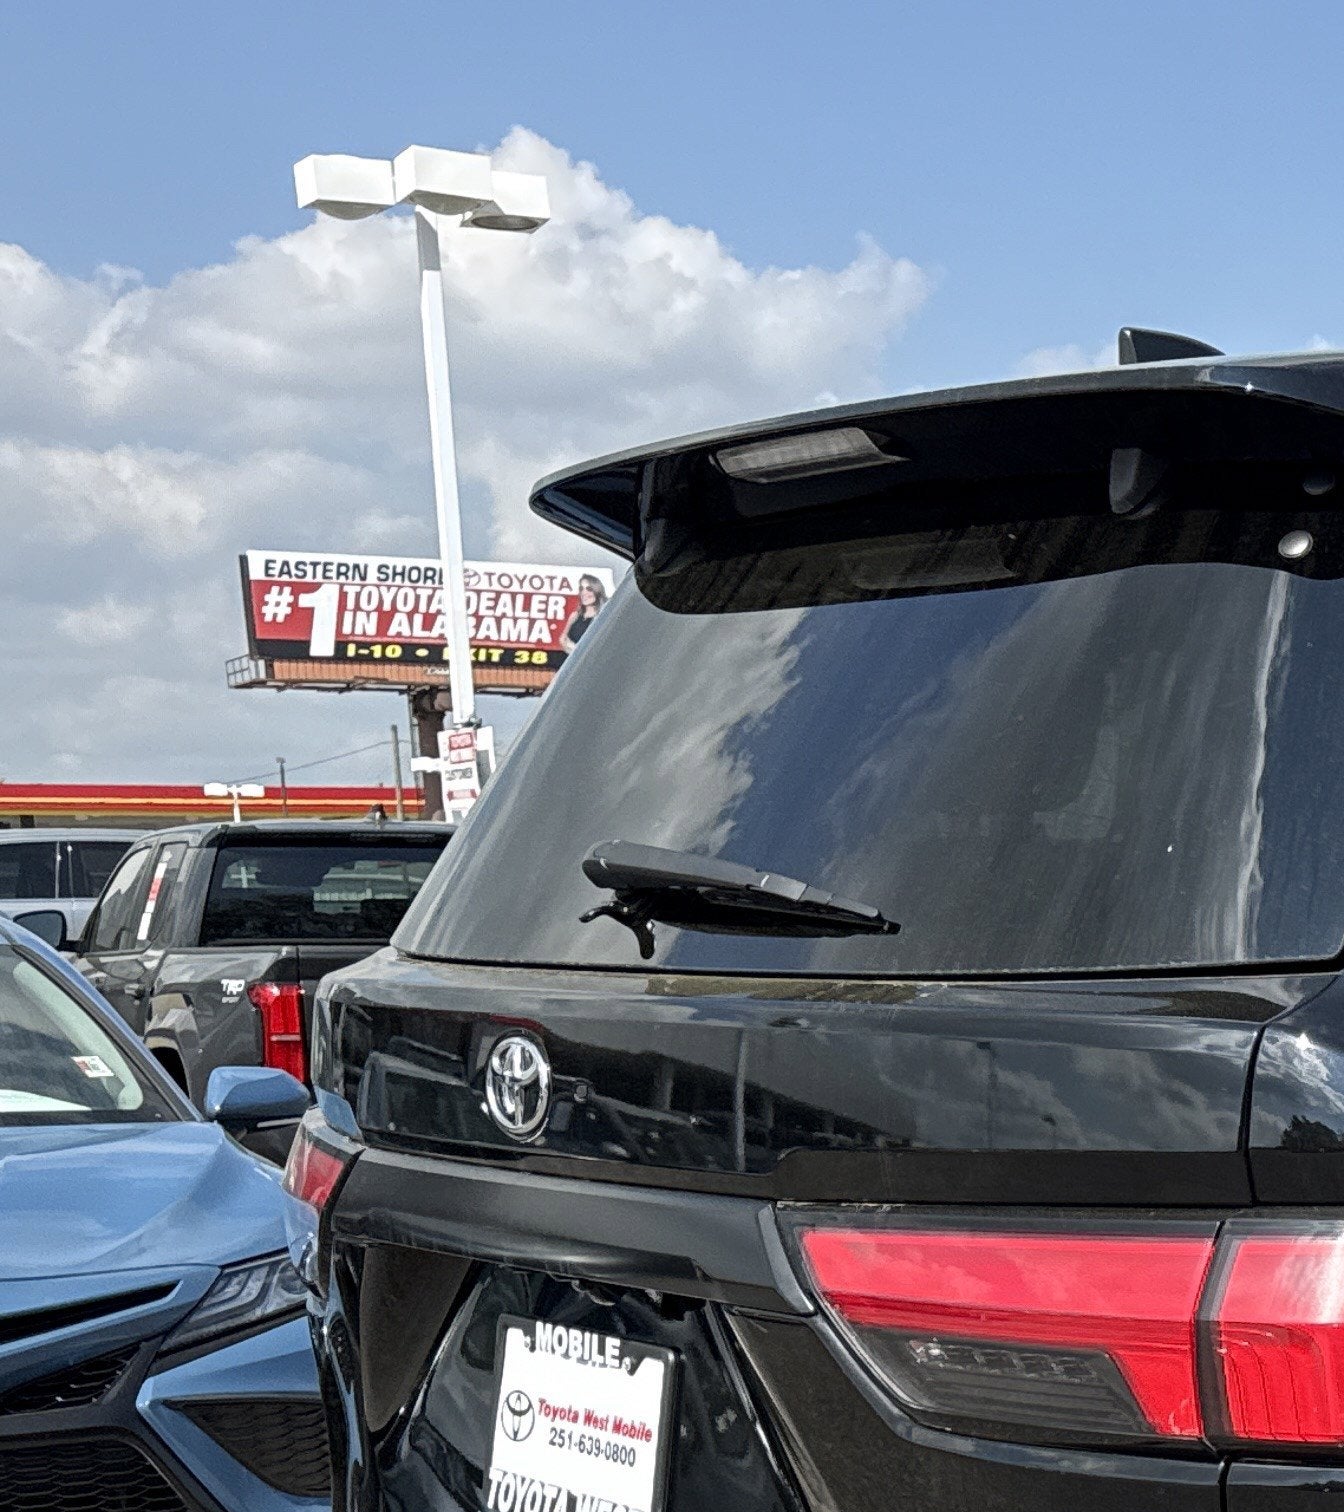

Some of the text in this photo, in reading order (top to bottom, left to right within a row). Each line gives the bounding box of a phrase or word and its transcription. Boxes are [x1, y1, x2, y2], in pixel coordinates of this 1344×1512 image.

[264, 559, 369, 582] EASTERN
[484, 572, 573, 592] TOYOTA
[261, 584, 340, 657] #1
[342, 611, 379, 636] IN
[346, 643, 403, 659] I-10
[514, 650, 549, 665] 38
[535, 1320, 622, 1369] MOBILE
[538, 1397, 654, 1443] Toyota West Mobile
[548, 1427, 637, 1468] 251-639-0800
